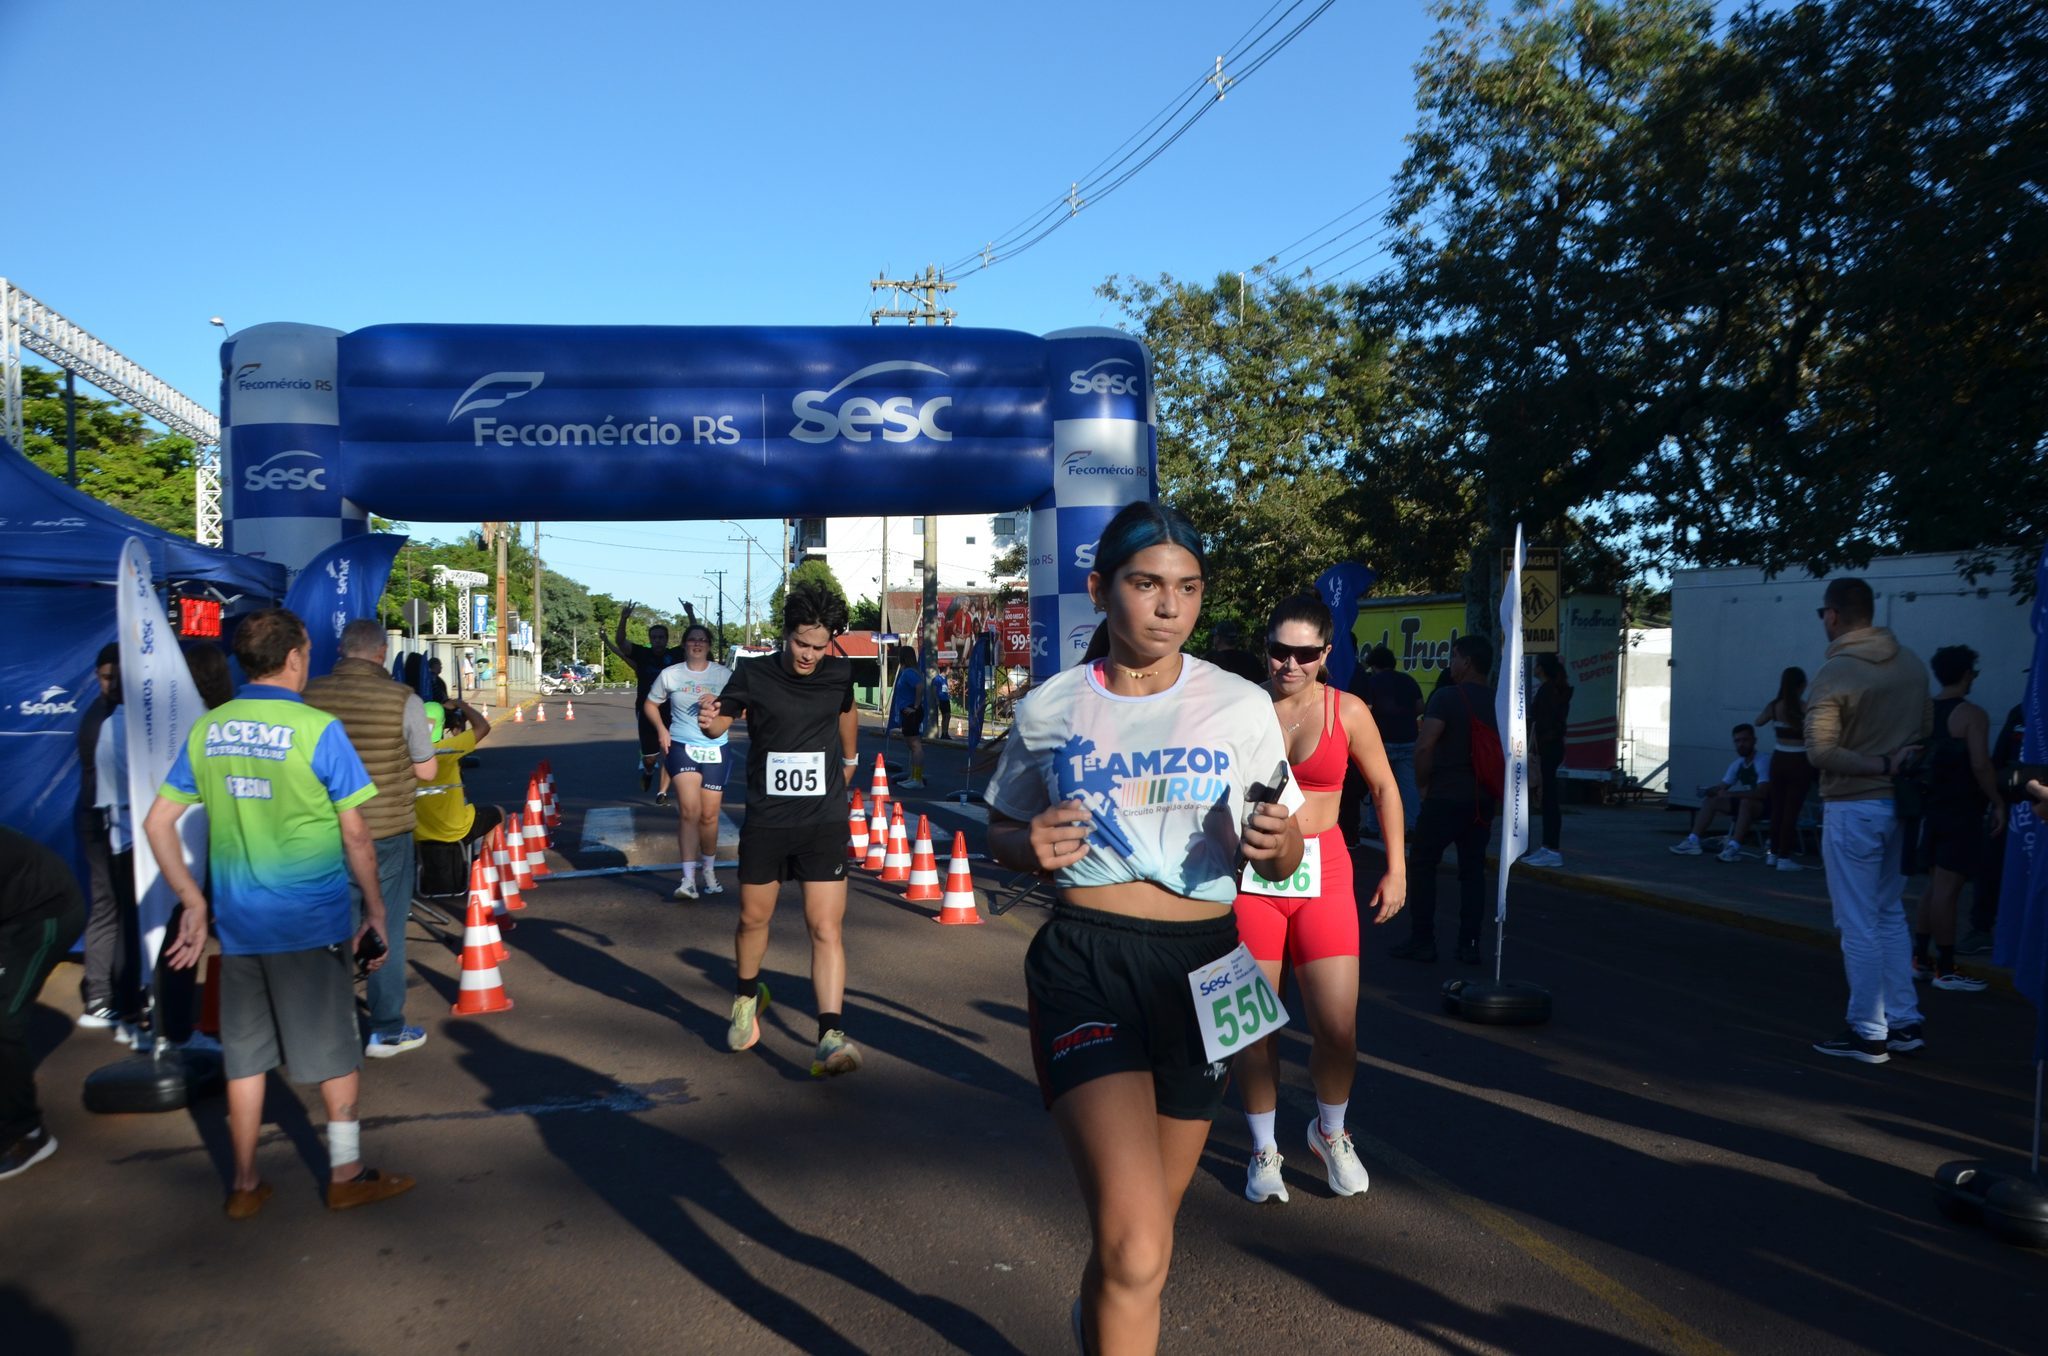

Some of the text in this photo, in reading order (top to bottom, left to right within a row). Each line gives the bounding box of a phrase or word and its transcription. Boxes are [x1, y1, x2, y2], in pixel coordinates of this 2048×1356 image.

[239, 378, 333, 392] Fecomércio RS
[1069, 368, 1138, 396] Sesc
[788, 388, 952, 444] Sesc
[473, 415, 741, 446] Fecomércio RS
[244, 463, 327, 491] Sesc
[1068, 464, 1148, 477] Fecomércio RS
[1042, 554, 1054, 565] RS
[141, 619, 154, 655] Sesc
[20, 700, 78, 715] Senac
[206, 719, 295, 750] ACEMI
[1105, 747, 1230, 779] AMZOP
[1516, 740, 1523, 760] RS
[775, 769, 817, 791] 805
[1167, 776, 1231, 803] RUN
[1123, 807, 1153, 817] Circuito
[1156, 803, 1182, 815] Região
[1184, 802, 1194, 811] da
[1513, 761, 1523, 838] Fecomércio
[1200, 971, 1232, 996] Sesc
[1212, 975, 1279, 1047] 550
